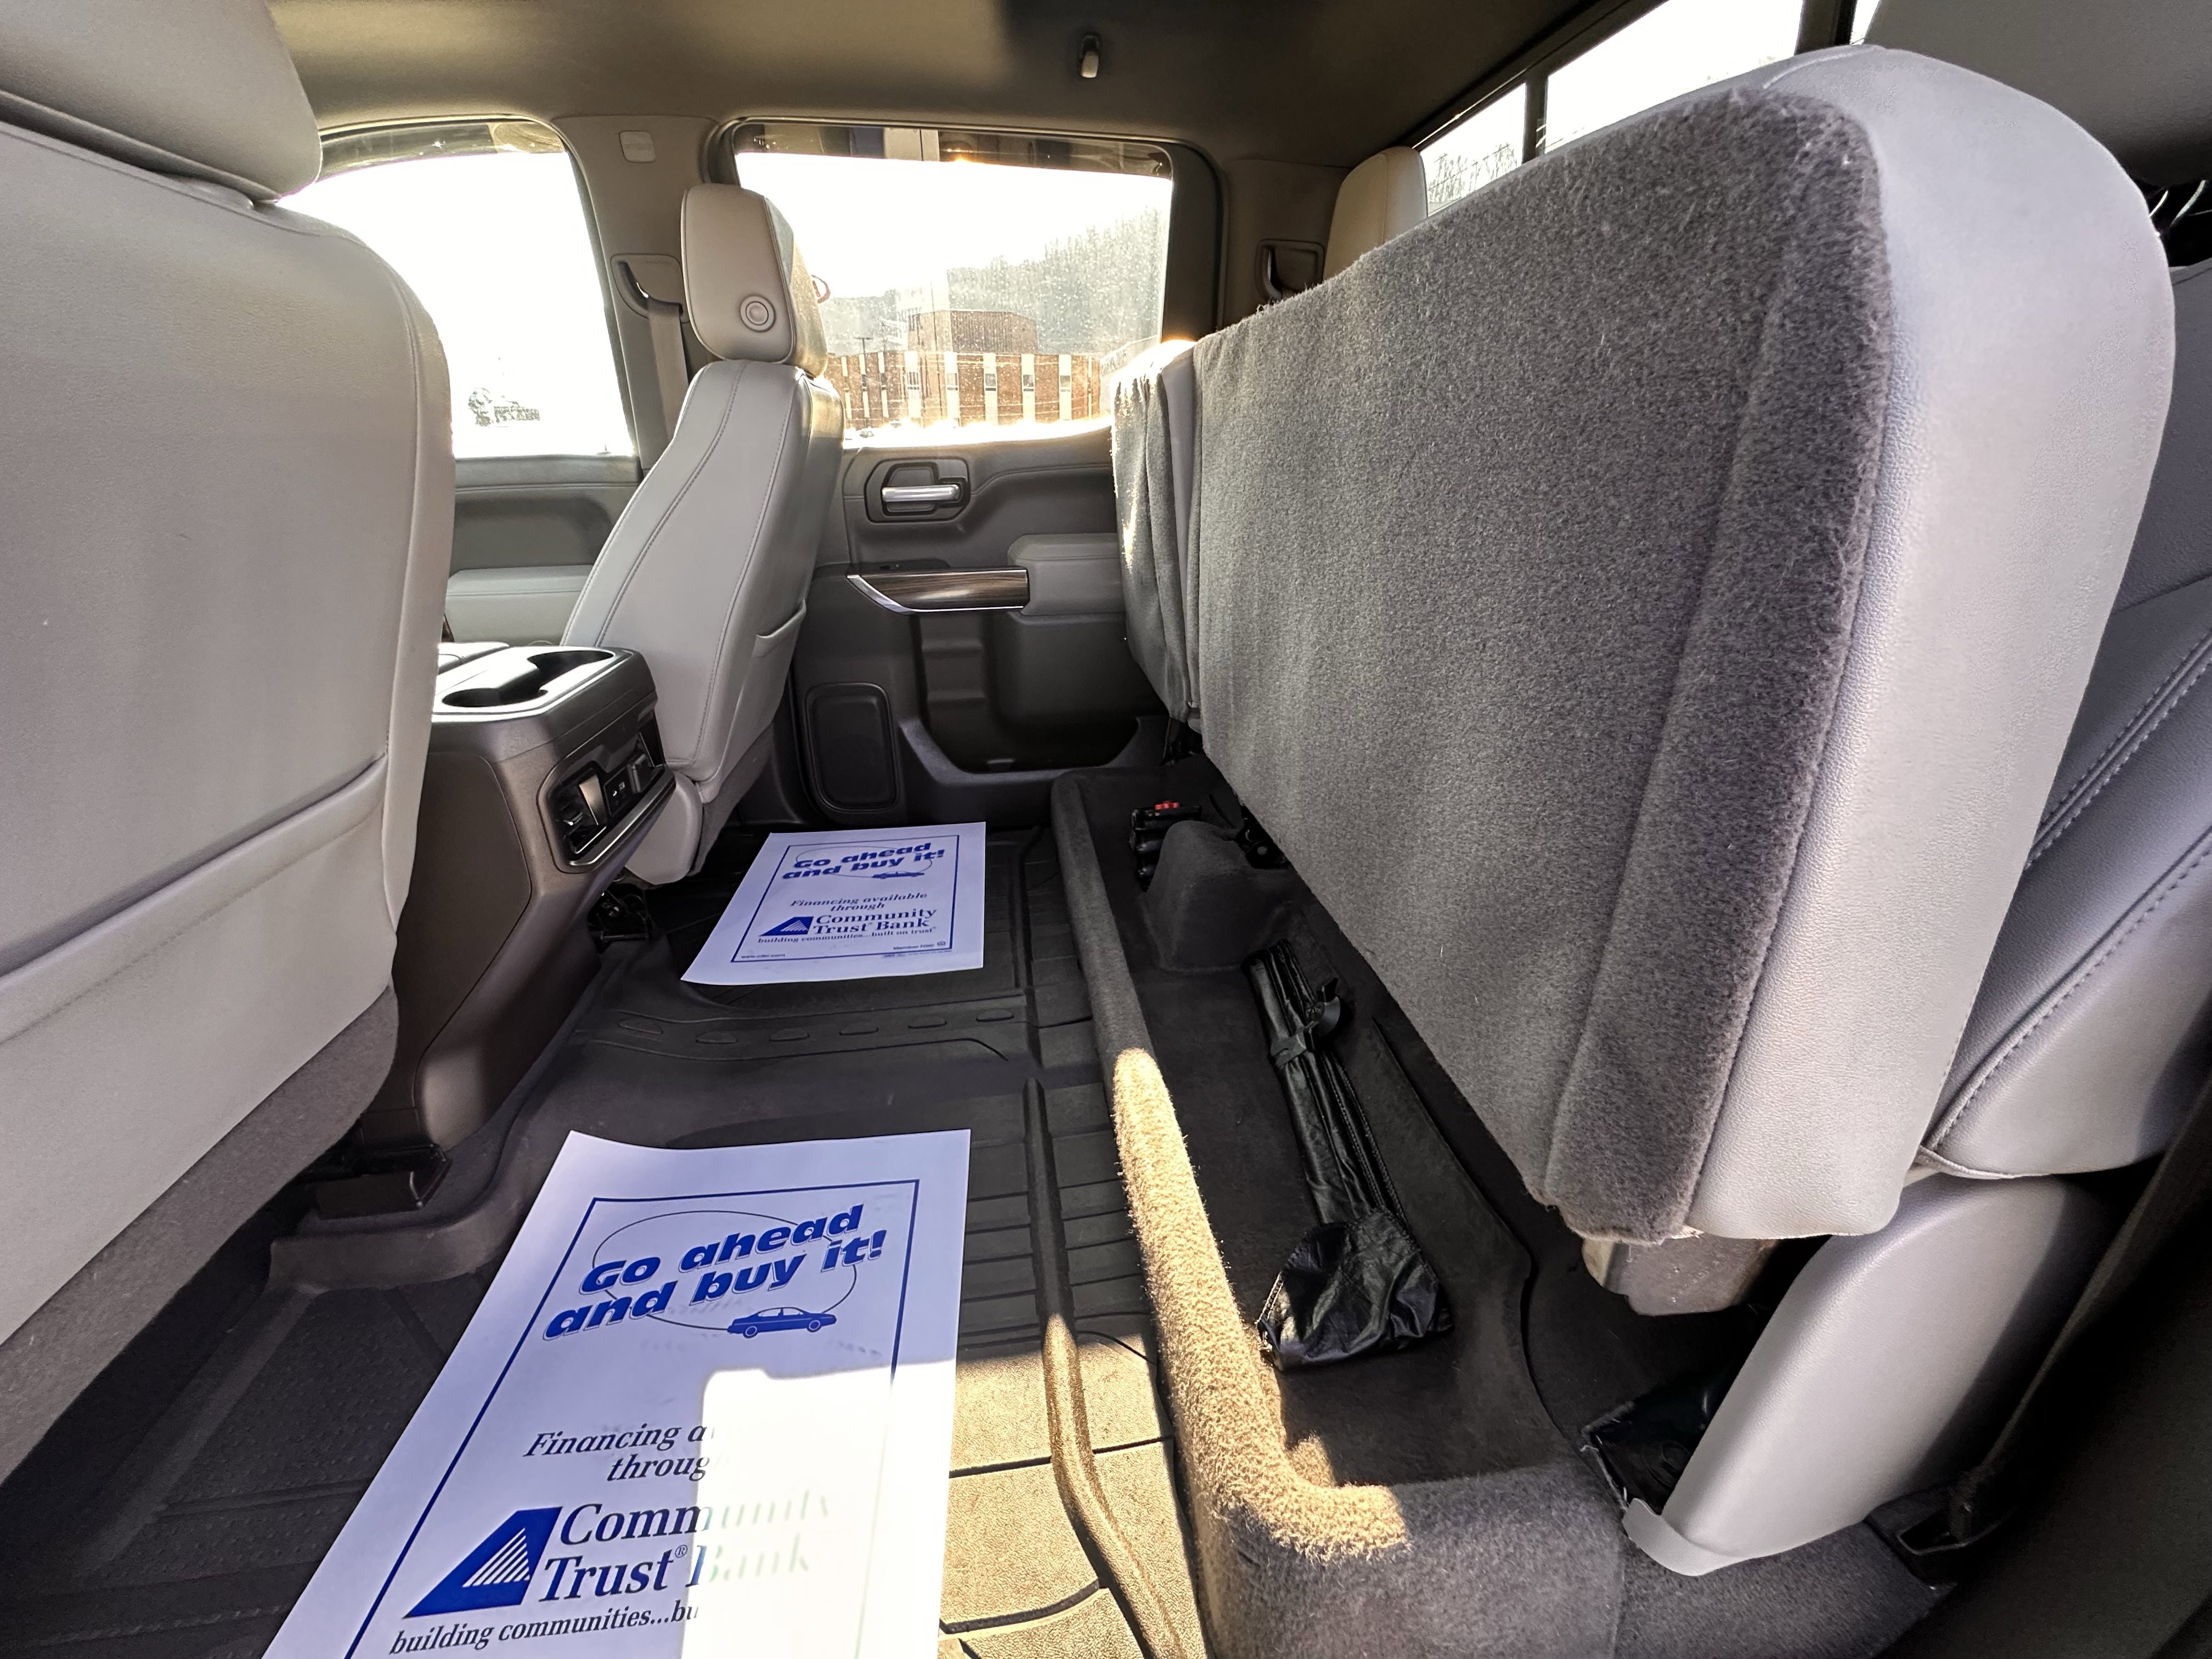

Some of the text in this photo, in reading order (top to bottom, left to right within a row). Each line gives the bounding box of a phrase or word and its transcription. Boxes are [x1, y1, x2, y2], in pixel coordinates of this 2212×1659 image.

[782, 849, 945, 879] and buy it!
[794, 843, 931, 868] Go ahead
[790, 893, 928, 906] Financing available
[830, 902, 885, 912] through
[816, 909, 938, 924] Community
[876, 918, 930, 930] Bank
[579, 1204, 865, 1295] Go ahead
[543, 1229, 887, 1340] and buy it!
[525, 1423, 682, 1457] Financing
[607, 1453, 710, 1482] throug
[389, 1623, 494, 1655] building
